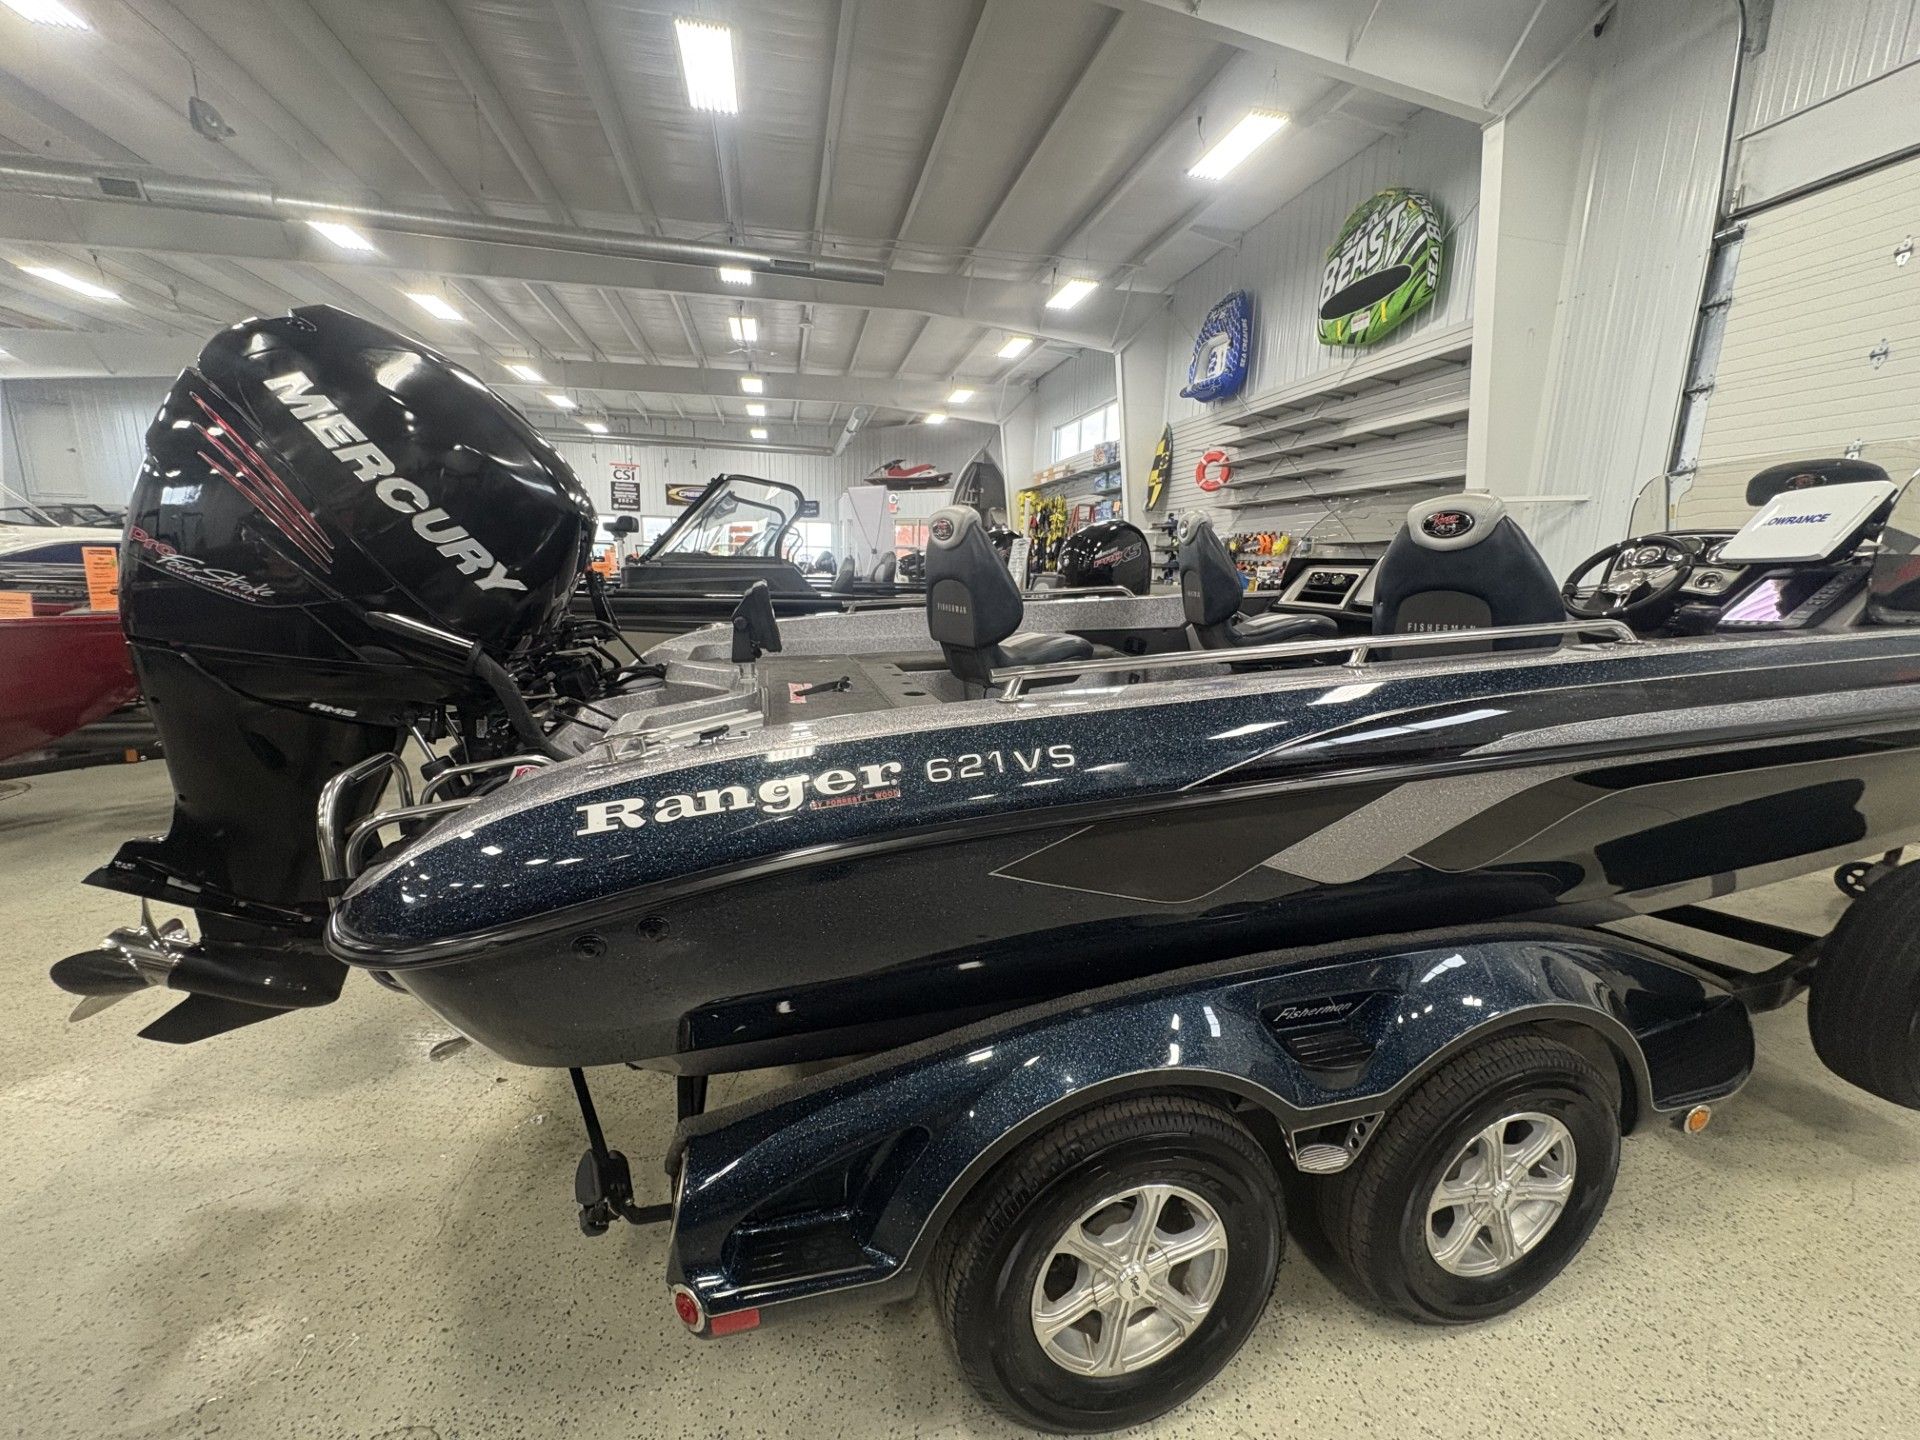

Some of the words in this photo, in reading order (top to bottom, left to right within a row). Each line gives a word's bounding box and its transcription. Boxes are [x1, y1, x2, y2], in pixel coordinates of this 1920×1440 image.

[1320, 199, 1407, 304] BEAST
[1343, 213, 1381, 249] SEA
[1426, 246, 1440, 289] SEA
[263, 371, 529, 591] MERCURY
[576, 762, 902, 836] Ranger
[1273, 1003, 1353, 1022] Fisherman
